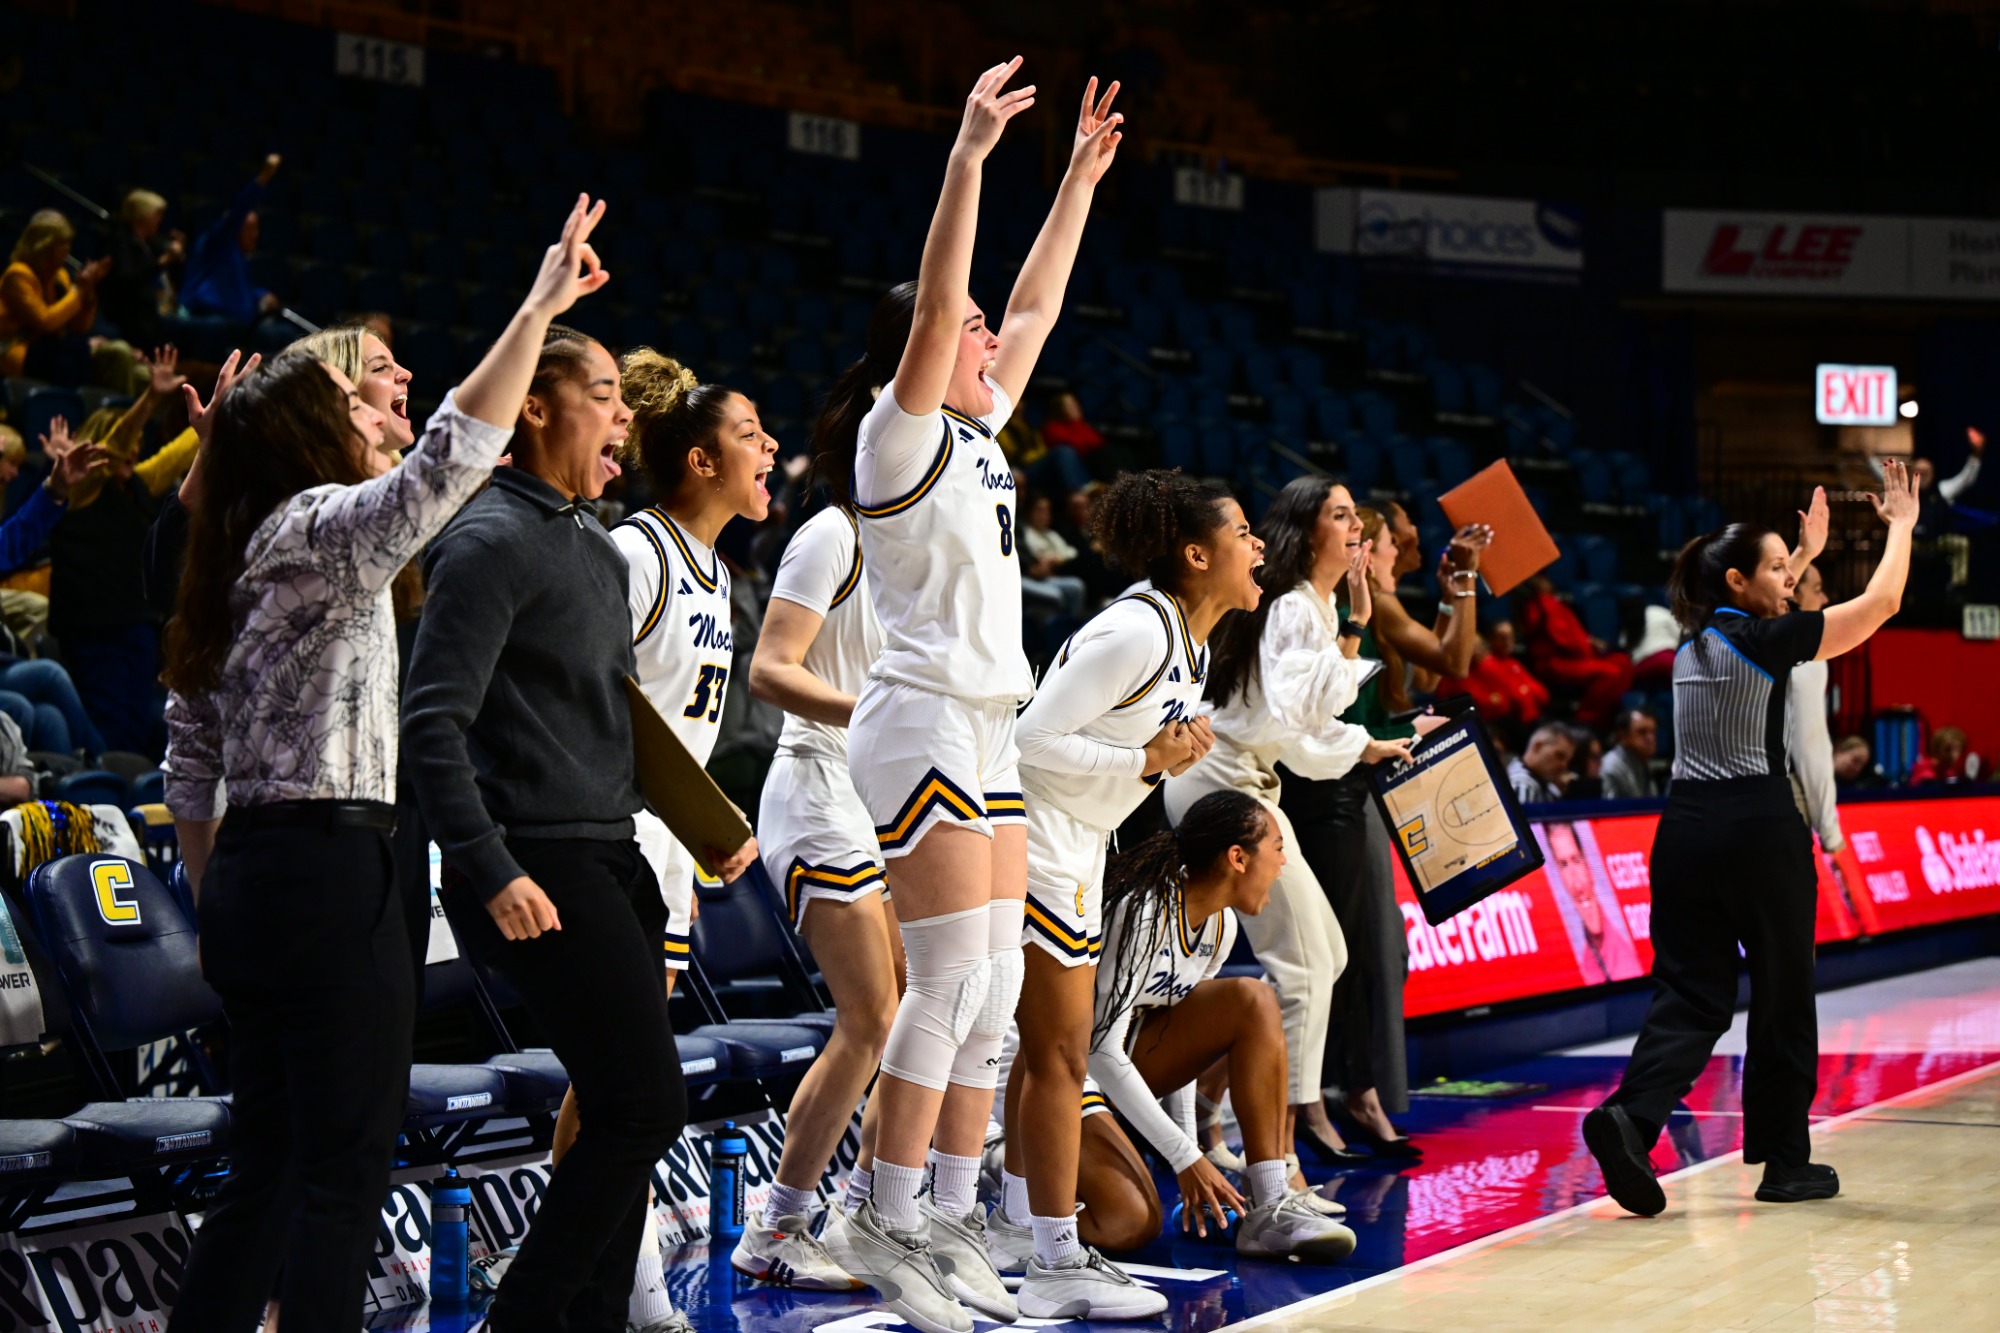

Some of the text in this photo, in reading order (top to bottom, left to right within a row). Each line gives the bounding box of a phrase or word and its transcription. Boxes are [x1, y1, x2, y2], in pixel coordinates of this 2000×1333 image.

[353, 41, 408, 83] 115
[801, 119, 847, 156] 116
[1187, 173, 1229, 206] 117
[1763, 225, 1864, 263] LEE
[1824, 372, 1888, 416] EXIT
[995, 502, 1013, 558] 8
[689, 612, 732, 652] Moc
[683, 663, 728, 724] 33
[1385, 728, 1469, 782] ATANOOGA
[90, 860, 142, 926] C
[1400, 890, 1538, 972] ateFarm
[1145, 971, 1193, 998] Moc
[157, 1132, 211, 1152] CHATTANOOGA
[0, 1155, 50, 1171] ATTANOOGA
[467, 1164, 552, 1252] pa
[656, 1203, 712, 1227] LTH GROU
[391, 1257, 431, 1276] WEALT
[396, 1282, 427, 1302] DAN
[93, 1319, 159, 1333] ALTH
